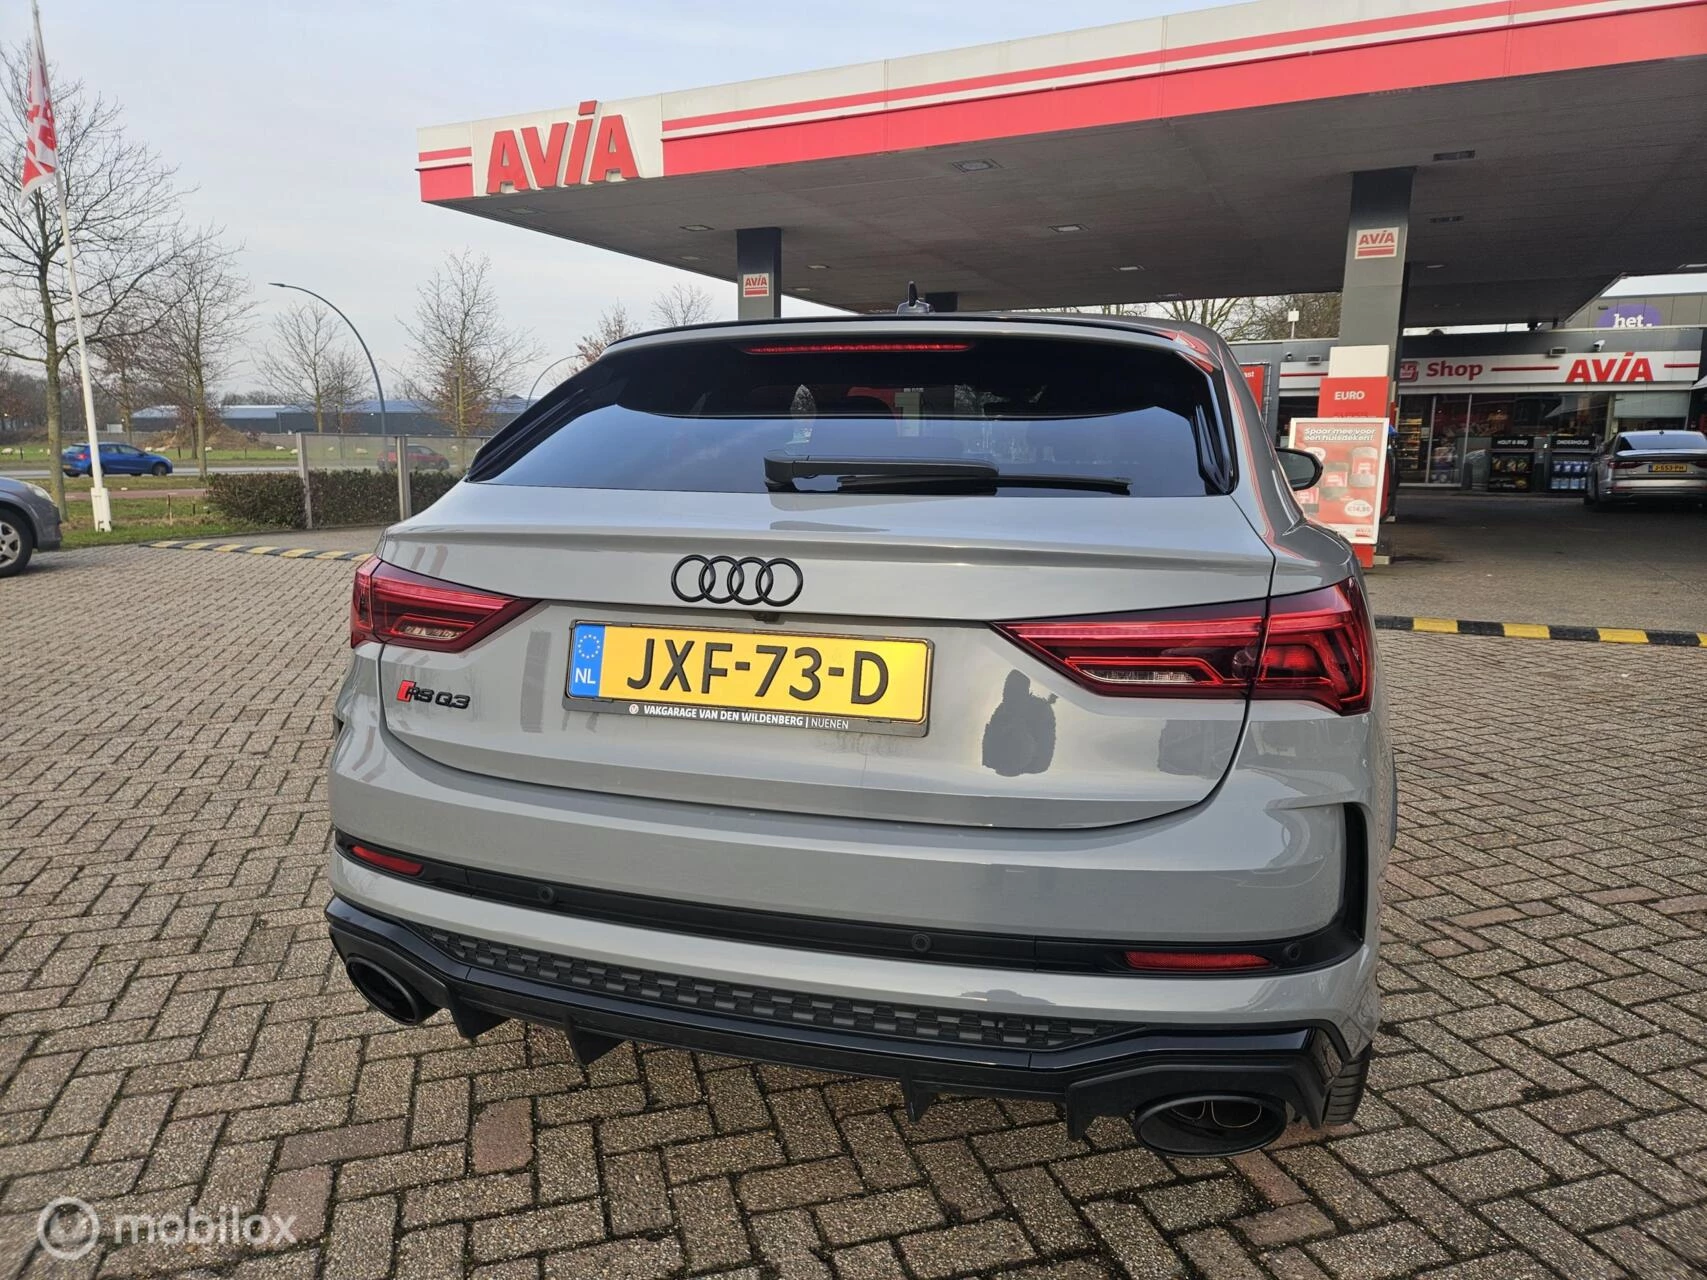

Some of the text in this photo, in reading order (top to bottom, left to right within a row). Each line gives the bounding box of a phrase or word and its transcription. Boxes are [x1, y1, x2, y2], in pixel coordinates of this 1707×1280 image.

[1426, 360, 1483, 381] Shop
[1334, 391, 1366, 400] EURO
[575, 667, 596, 685] NL
[627, 638, 890, 705] JXF-73-D
[643, 705, 849, 730] VAKGARAGE VAN DEN WILDENBERG NUENEN
